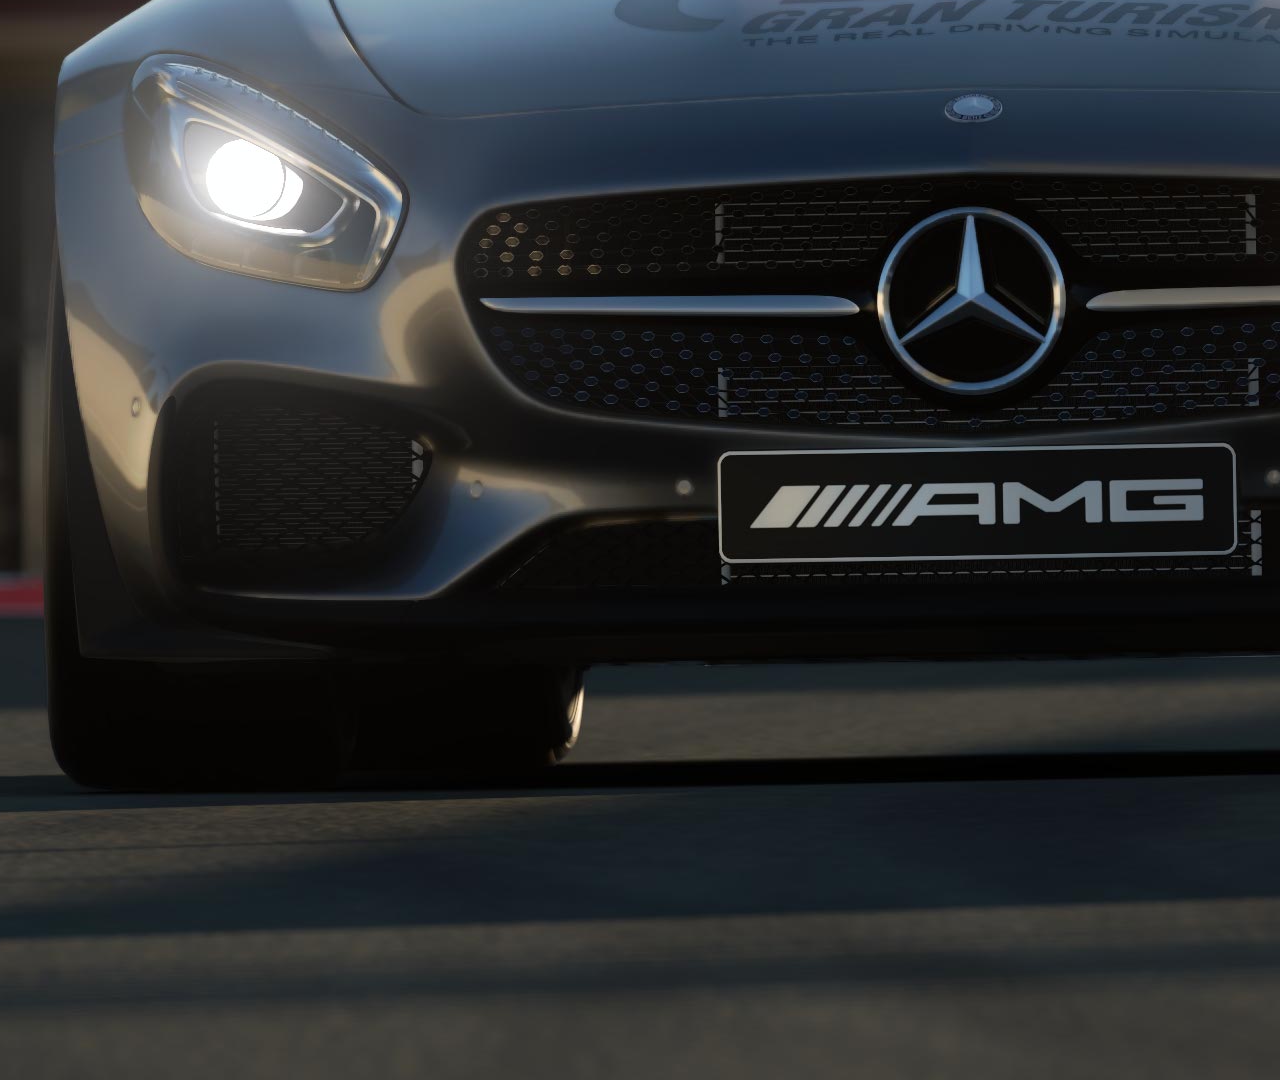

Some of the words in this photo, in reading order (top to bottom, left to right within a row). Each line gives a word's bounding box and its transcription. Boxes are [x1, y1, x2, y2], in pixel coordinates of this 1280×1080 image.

[741, 0, 987, 35] GRAN
[743, 35, 819, 47] THE
[833, 28, 936, 42] REAL
[949, 23, 1112, 36] DRIVING
[891, 478, 1205, 527] AMG
